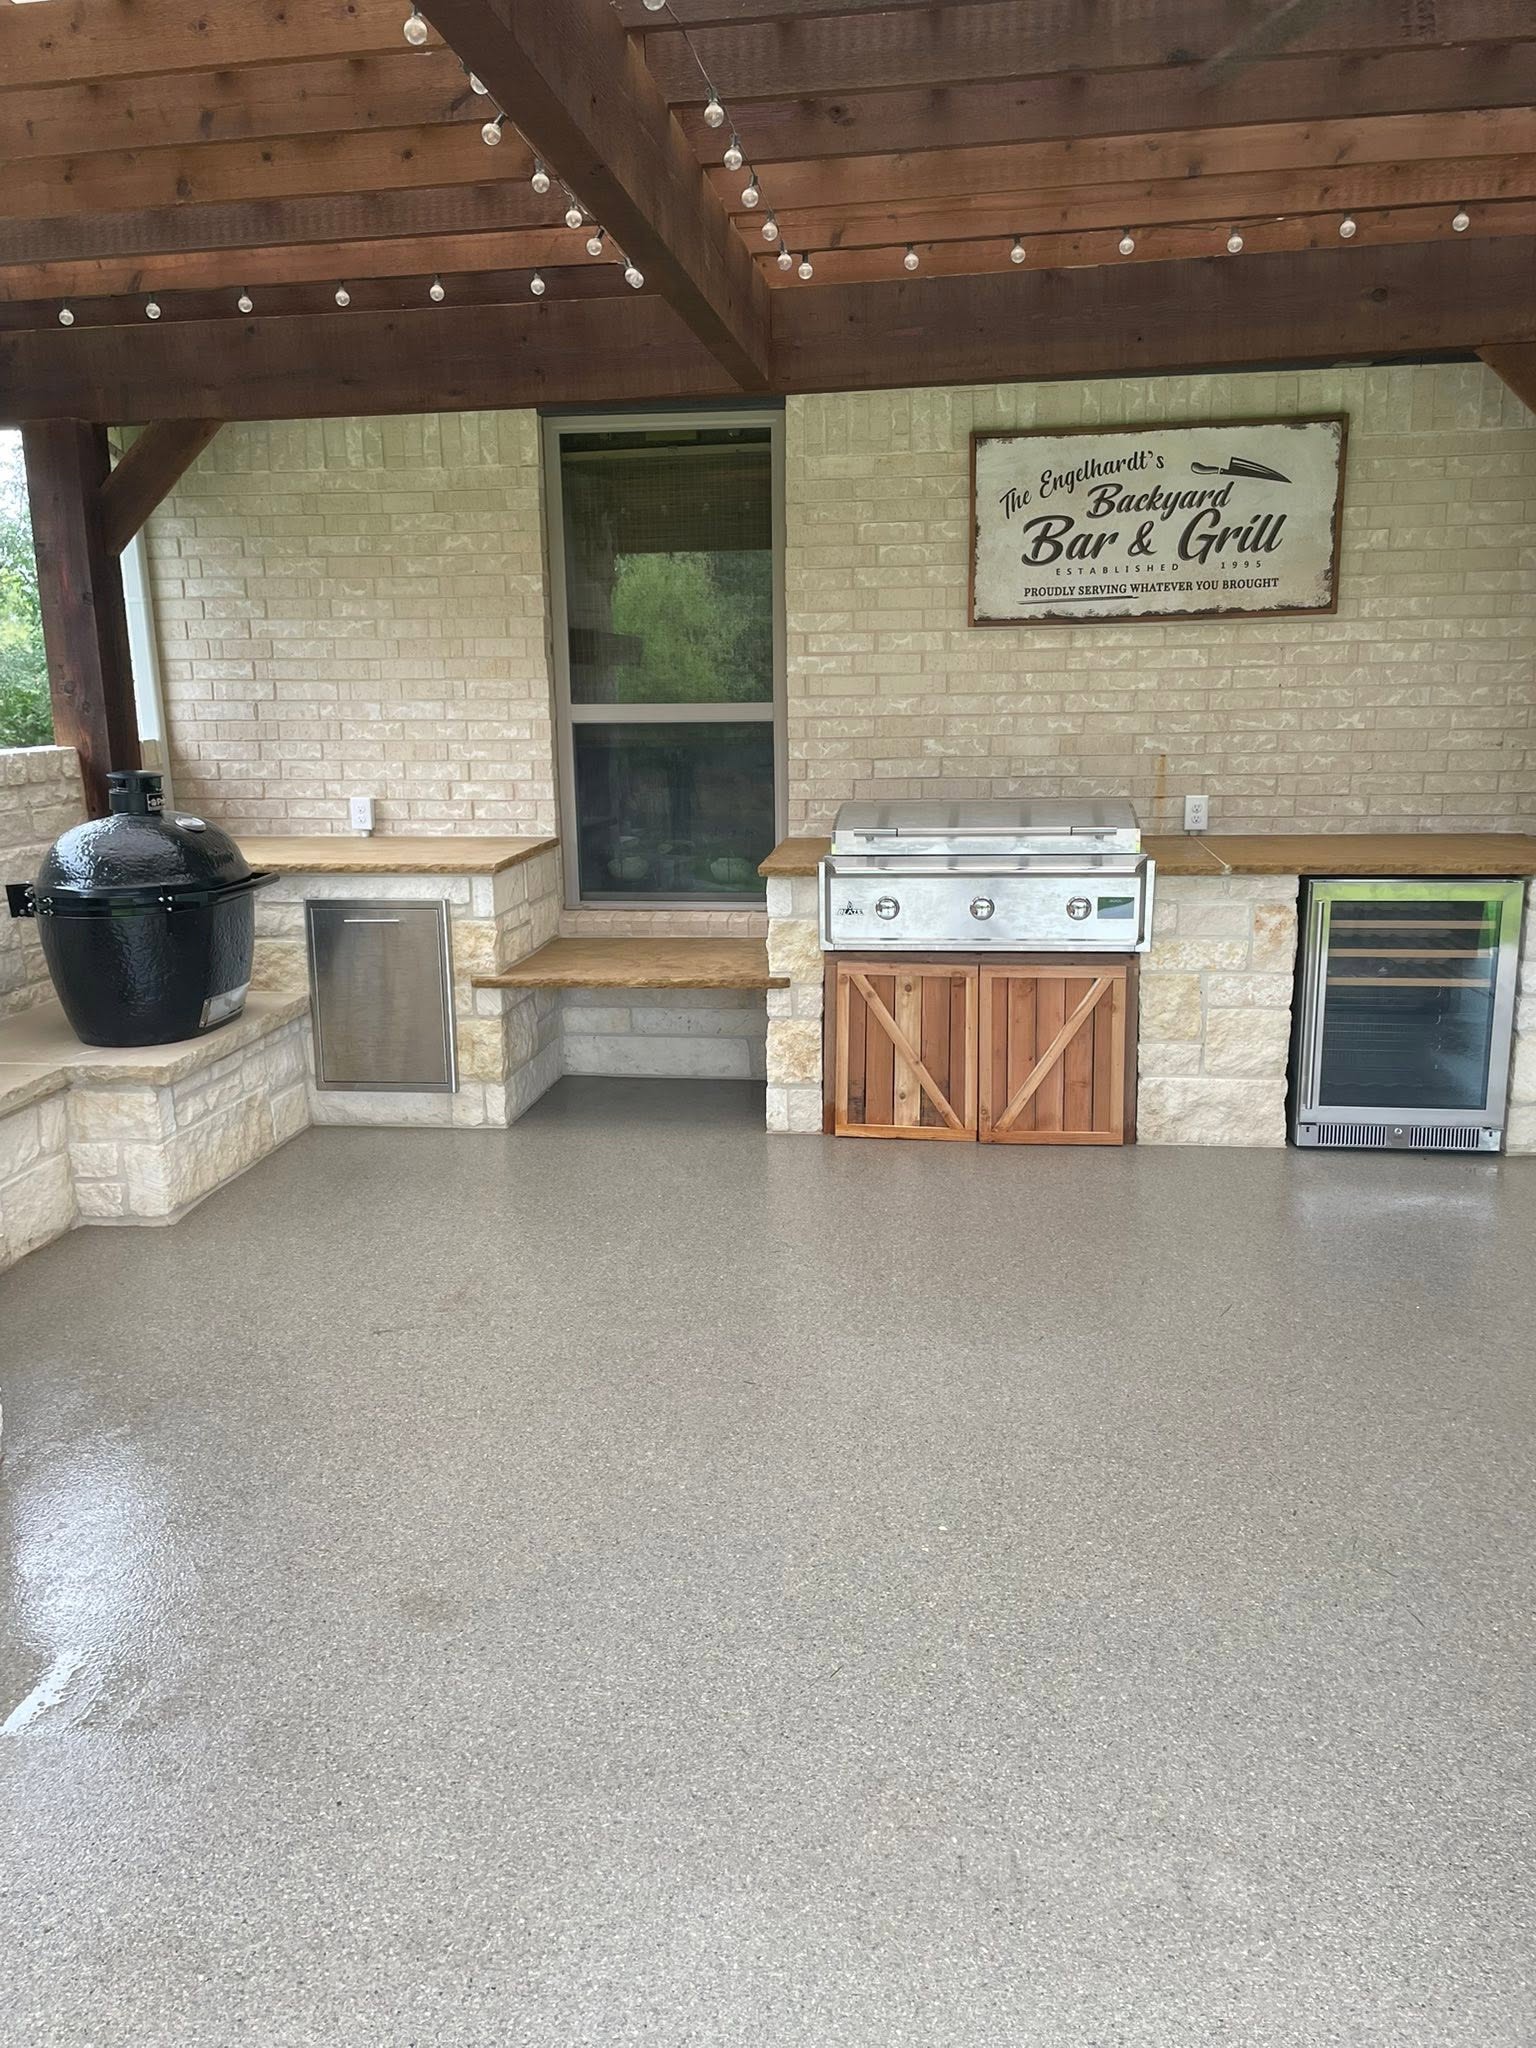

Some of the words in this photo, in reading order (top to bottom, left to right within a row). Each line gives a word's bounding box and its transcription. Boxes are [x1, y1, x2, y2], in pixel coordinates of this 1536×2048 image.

[999, 487, 1033, 520] The
[1039, 450, 1165, 499] Engelhardt's
[1086, 480, 1235, 522] Backyard
[1020, 514, 1120, 567] Bar
[1127, 520, 1158, 557] &
[1177, 507, 1288, 565] Grill
[1024, 585, 1076, 598] PROUDLY
[1078, 583, 1127, 596] SERVING
[1130, 581, 1193, 594] WHATEVER
[1196, 579, 1220, 592] YOU
[1222, 577, 1280, 590] BROUGHT
[1055, 562, 1180, 576] ESTABLISHED
[1220, 559, 1262, 570] 1995
